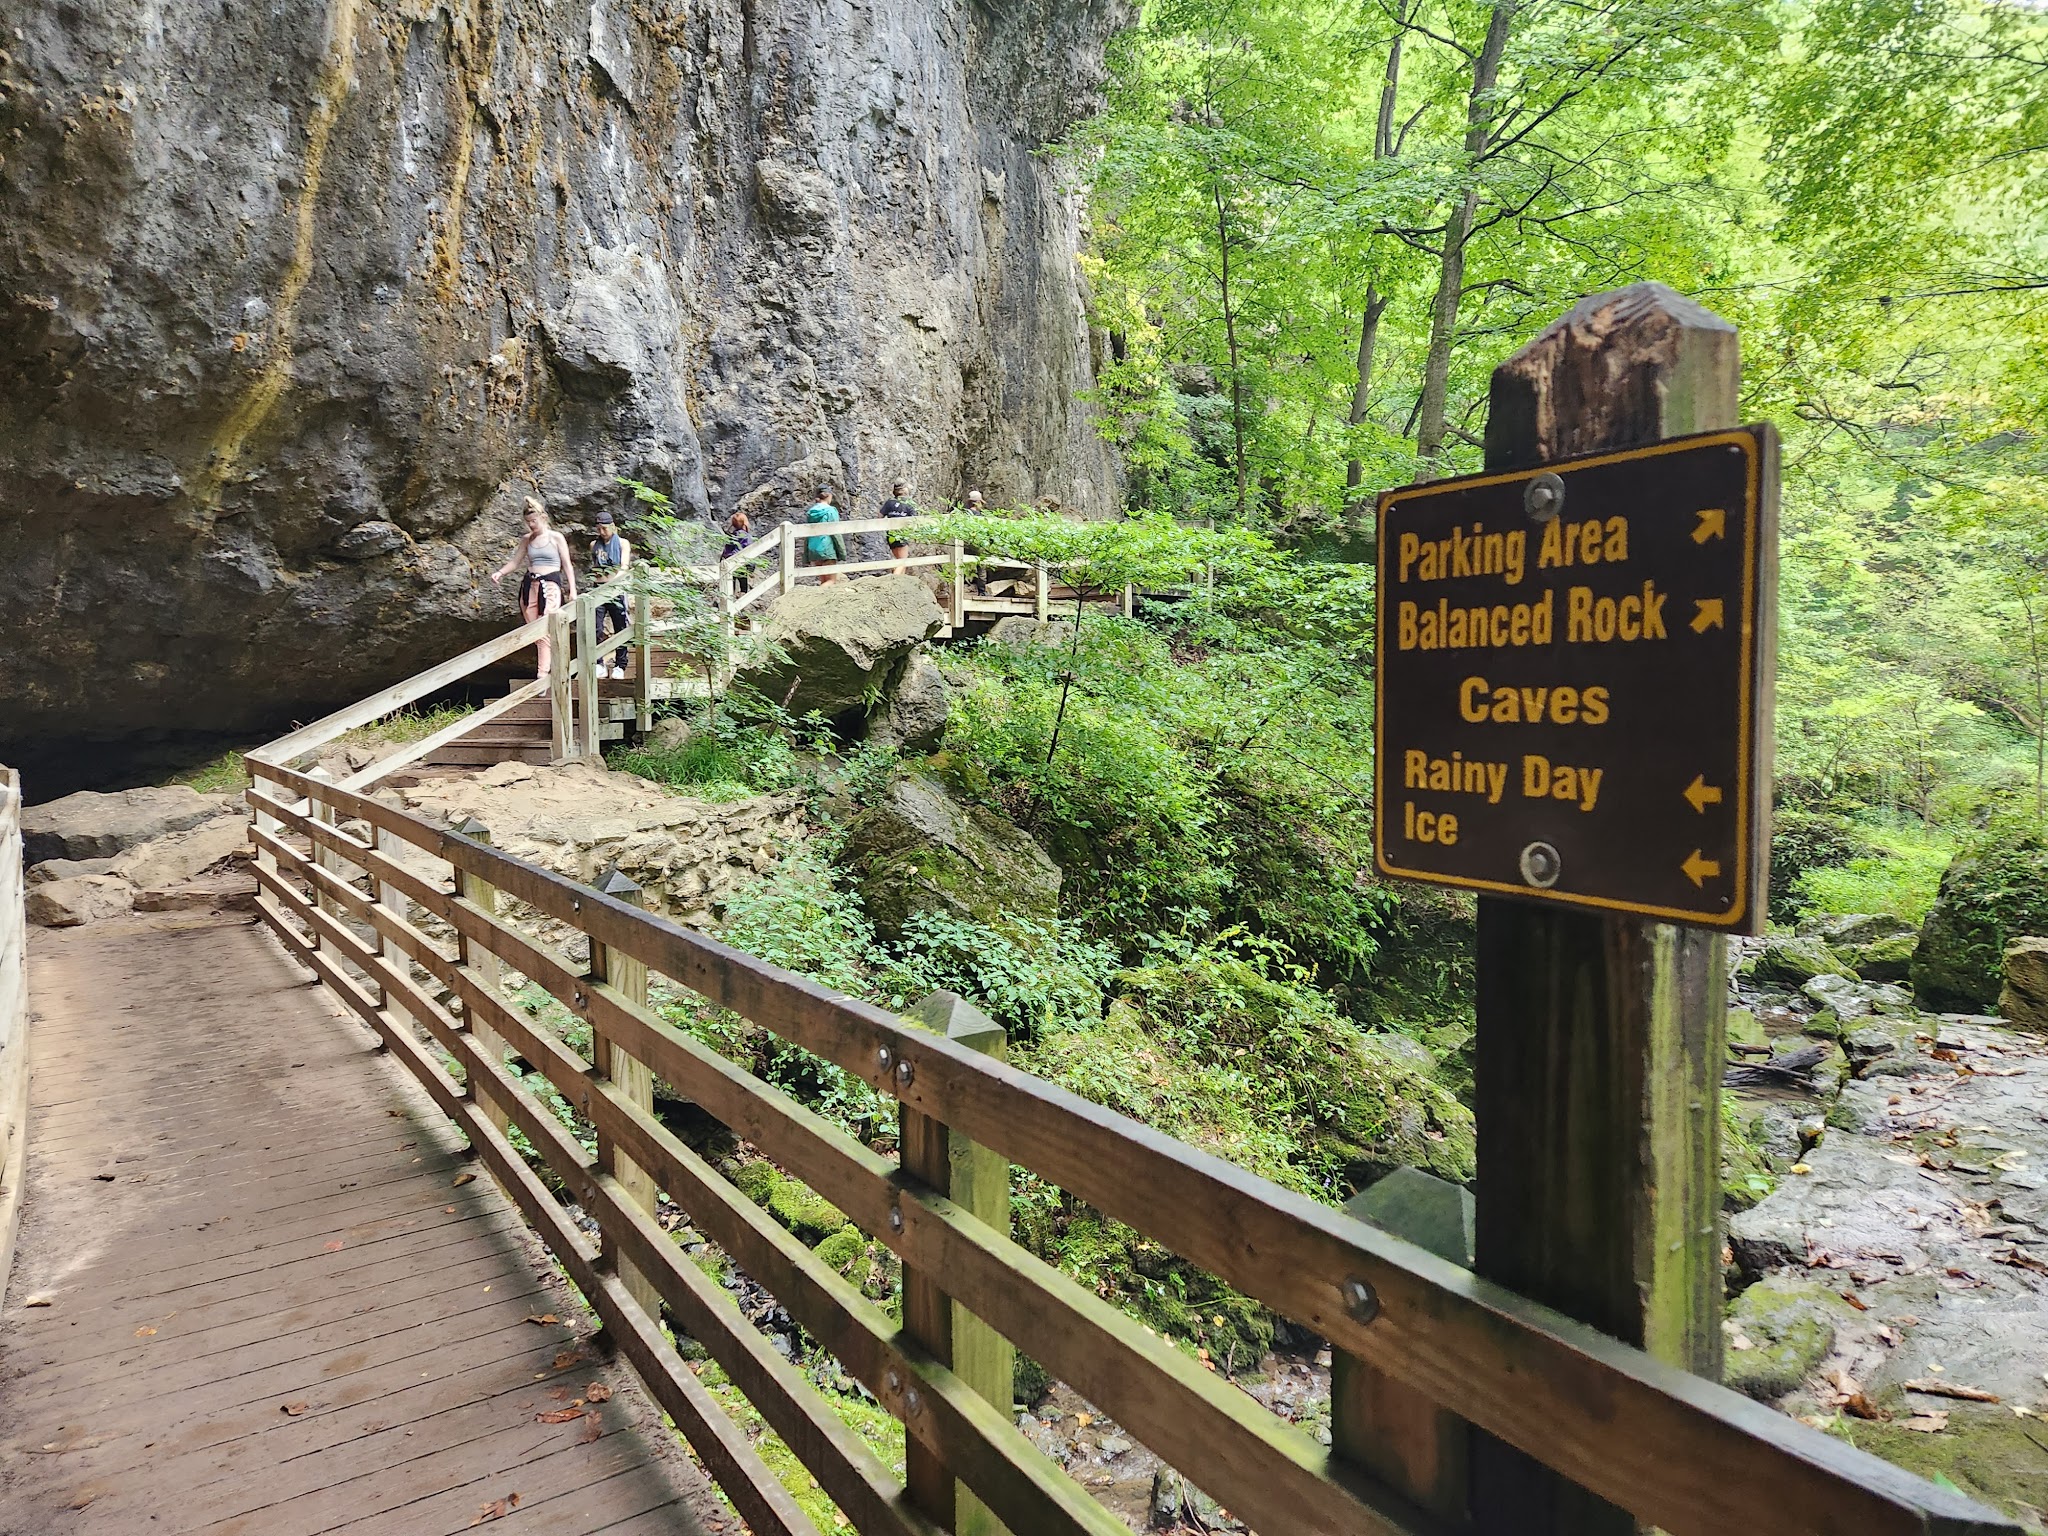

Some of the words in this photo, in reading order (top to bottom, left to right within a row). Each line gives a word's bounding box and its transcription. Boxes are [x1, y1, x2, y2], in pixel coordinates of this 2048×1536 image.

[1399, 522, 1526, 585] Parking
[1538, 515, 1629, 568] Area
[1399, 589, 1553, 650] Balanced
[1567, 579, 1667, 642] Rock
[1459, 676, 1610, 724] Caves
[1404, 749, 1508, 804] Rainy
[1522, 754, 1603, 811] Day
[1404, 801, 1458, 845] Ice
